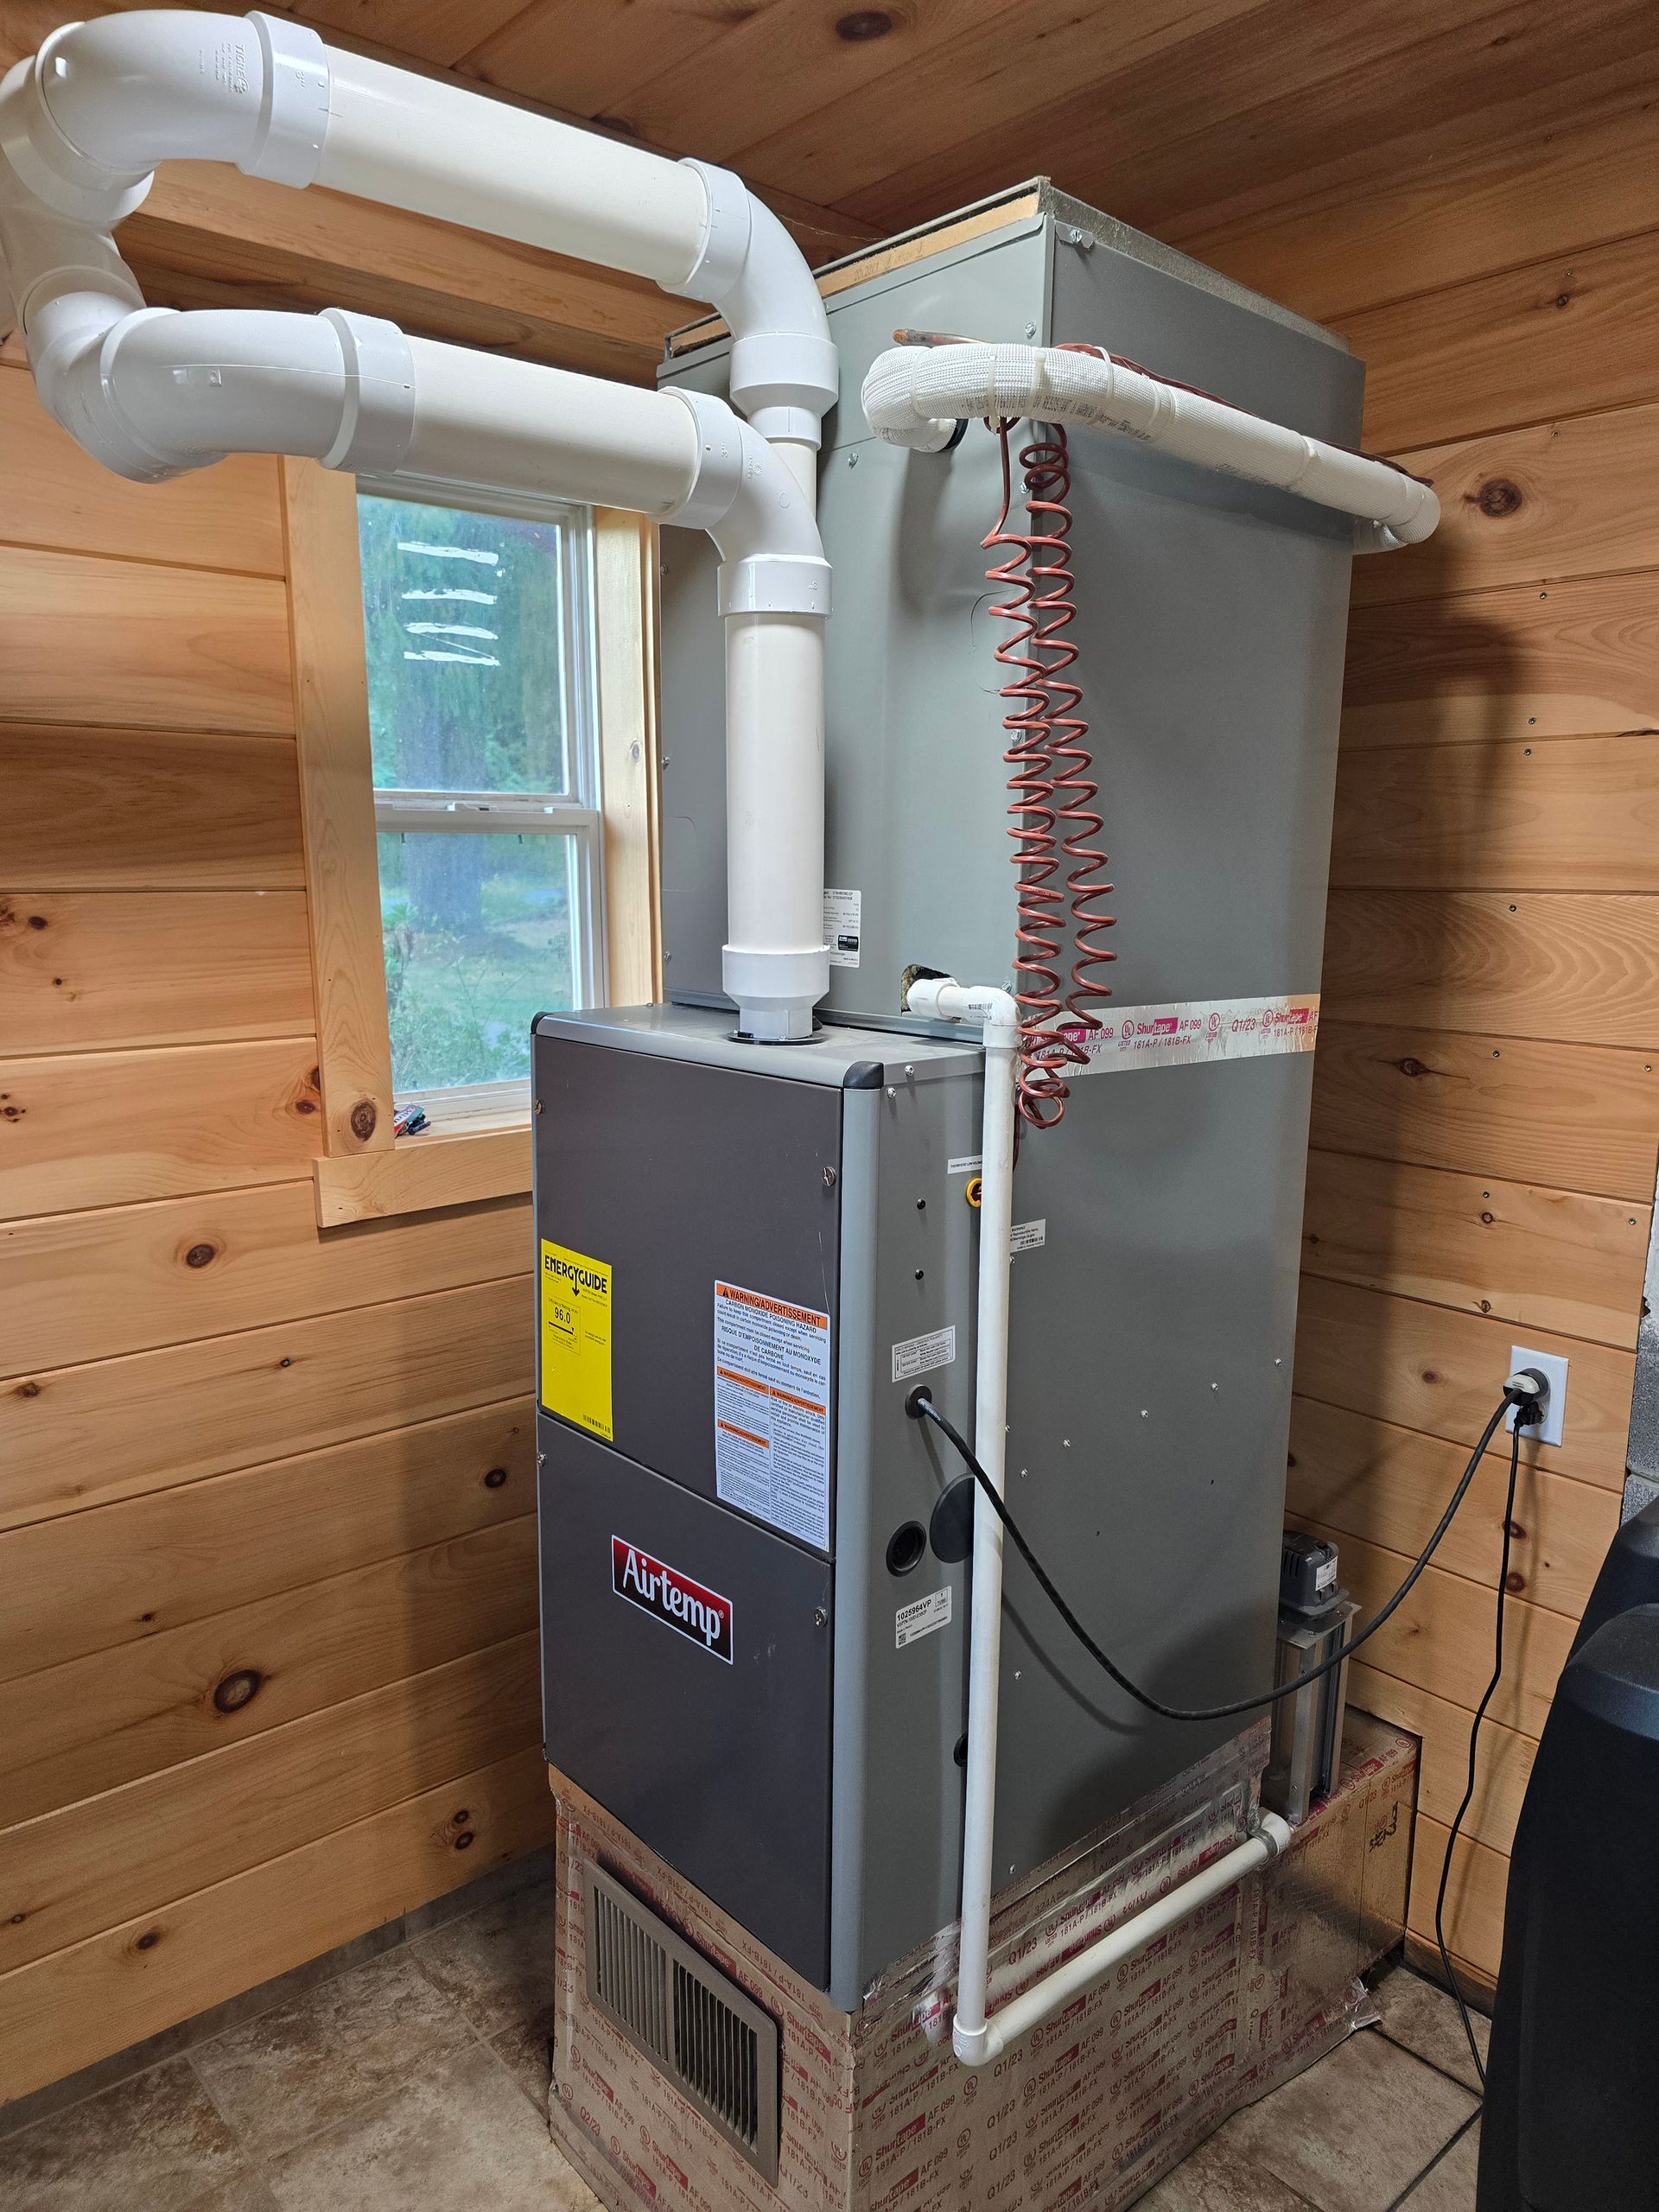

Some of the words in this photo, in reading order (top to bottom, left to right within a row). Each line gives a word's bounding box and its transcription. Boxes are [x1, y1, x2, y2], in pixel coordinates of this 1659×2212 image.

[1136, 1020, 1173, 1036] Shurtape
[1179, 1020, 1189, 1032] AF
[1190, 1019, 1202, 1031] 099
[1231, 1018, 1256, 1033] Q1/23
[1308, 1010, 1319, 1021] AF
[1101, 1027, 1114, 1040] 099
[1133, 1038, 1158, 1050] 181A-P
[1164, 1035, 1192, 1047] 181B-FX
[1274, 1027, 1294, 1038] 181A-P
[544, 1255, 607, 1295] ENERGYGUIDE
[554, 1306, 570, 1325] 96.0
[725, 1298, 744, 1312] CARBON
[744, 1304, 769, 1319] MONOXIDE
[769, 1312, 795, 1328] POISONING
[796, 1320, 817, 1334] HAZARD
[729, 1288, 822, 1326] WARNING/ADVERTISSEMENT
[721, 1325, 738, 1337] RISQUE
[738, 1330, 785, 1353] D'EMPOISONNEMENT
[785, 1346, 792, 1356] AU
[792, 1349, 822, 1365] MONOXYDE
[798, 1328, 808, 1338] when
[809, 1332, 827, 1344] servicing
[760, 1347, 785, 1361] CARBONE
[622, 1546, 721, 1646] Airtemp
[897, 1599, 931, 1622] 1025964VP
[1060, 1914, 1085, 1938] 181A-P
[1090, 1892, 1118, 1916] 181B-FX
[1008, 1936, 1038, 1965] Q1/23
[1130, 1941, 1163, 1971] Shurtape
[1167, 1929, 1178, 1944] AF
[1178, 1921, 1190, 1937] 099
[1130, 1961, 1153, 1983] 181A-P
[1157, 1938, 1183, 1962] 181B-FX
[696, 1930, 730, 1967] Shurtape
[738, 1969, 749, 1986] AF
[749, 1980, 764, 1999] 099
[778, 1974, 805, 2003] 181A-P
[1123, 1986, 1156, 2017] Shurtape
[1161, 1974, 1172, 1988] AF
[1172, 1964, 1184, 1981] 099
[1046, 2003, 1080, 2036] Shurtape
[1087, 1988, 1098, 2005] AF
[1097, 1979, 1111, 1998] 099
[1124, 2005, 1147, 2029] 181A-P
[1151, 1982, 1177, 2006] 181B-FX
[1046, 2023, 1071, 2049] 181A-P
[1076, 1999, 1103, 2026] 181B-FX
[891, 2029, 921, 2056] 181A-P
[1038, 2051, 1073, 2085] Shurtape
[1080, 2037, 1091, 2052] AF
[1091, 2026, 1104, 2044] 099
[994, 2048, 1023, 2078] Q1/23
[1039, 2072, 1064, 2097] 181A-P
[1069, 2046, 1097, 2074] 181B-FX
[614, 2098, 624, 2112] AF
[890, 2090, 919, 2119] 181A-P
[925, 2062, 959, 2092] 181B-FX
[1040, 2102, 1065, 2128] 181A-P
[1071, 2077, 1099, 2105] 181B-FX
[580, 2106, 601, 2137] Q2/23
[786, 2107, 817, 2144] 181B-FX
[875, 2121, 918, 2161] Shurtape
[927, 2106, 940, 2123] AF
[940, 2094, 956, 2113] 099
[987, 2098, 1016, 2130] Q1/23
[1039, 2120, 1074, 2154] Shurtape
[1080, 2103, 1091, 2118] AF
[1090, 2094, 1104, 2110] 099
[1069, 2113, 1097, 2140] 181B-FX
[875, 2145, 906, 2174] 181A-P
[912, 2114, 947, 2146] 181B-FX
[988, 2130, 1018, 2161] Q1/23
[786, 2145, 814, 2177] 181A-P
[920, 2158, 933, 2177] AF
[933, 2147, 949, 2166] 099
[1083, 2170, 1093, 2185] AF
[1092, 2159, 1106, 2177] 099
[689, 2185, 699, 2200] AF
[987, 2169, 1016, 2201] Q1/23
